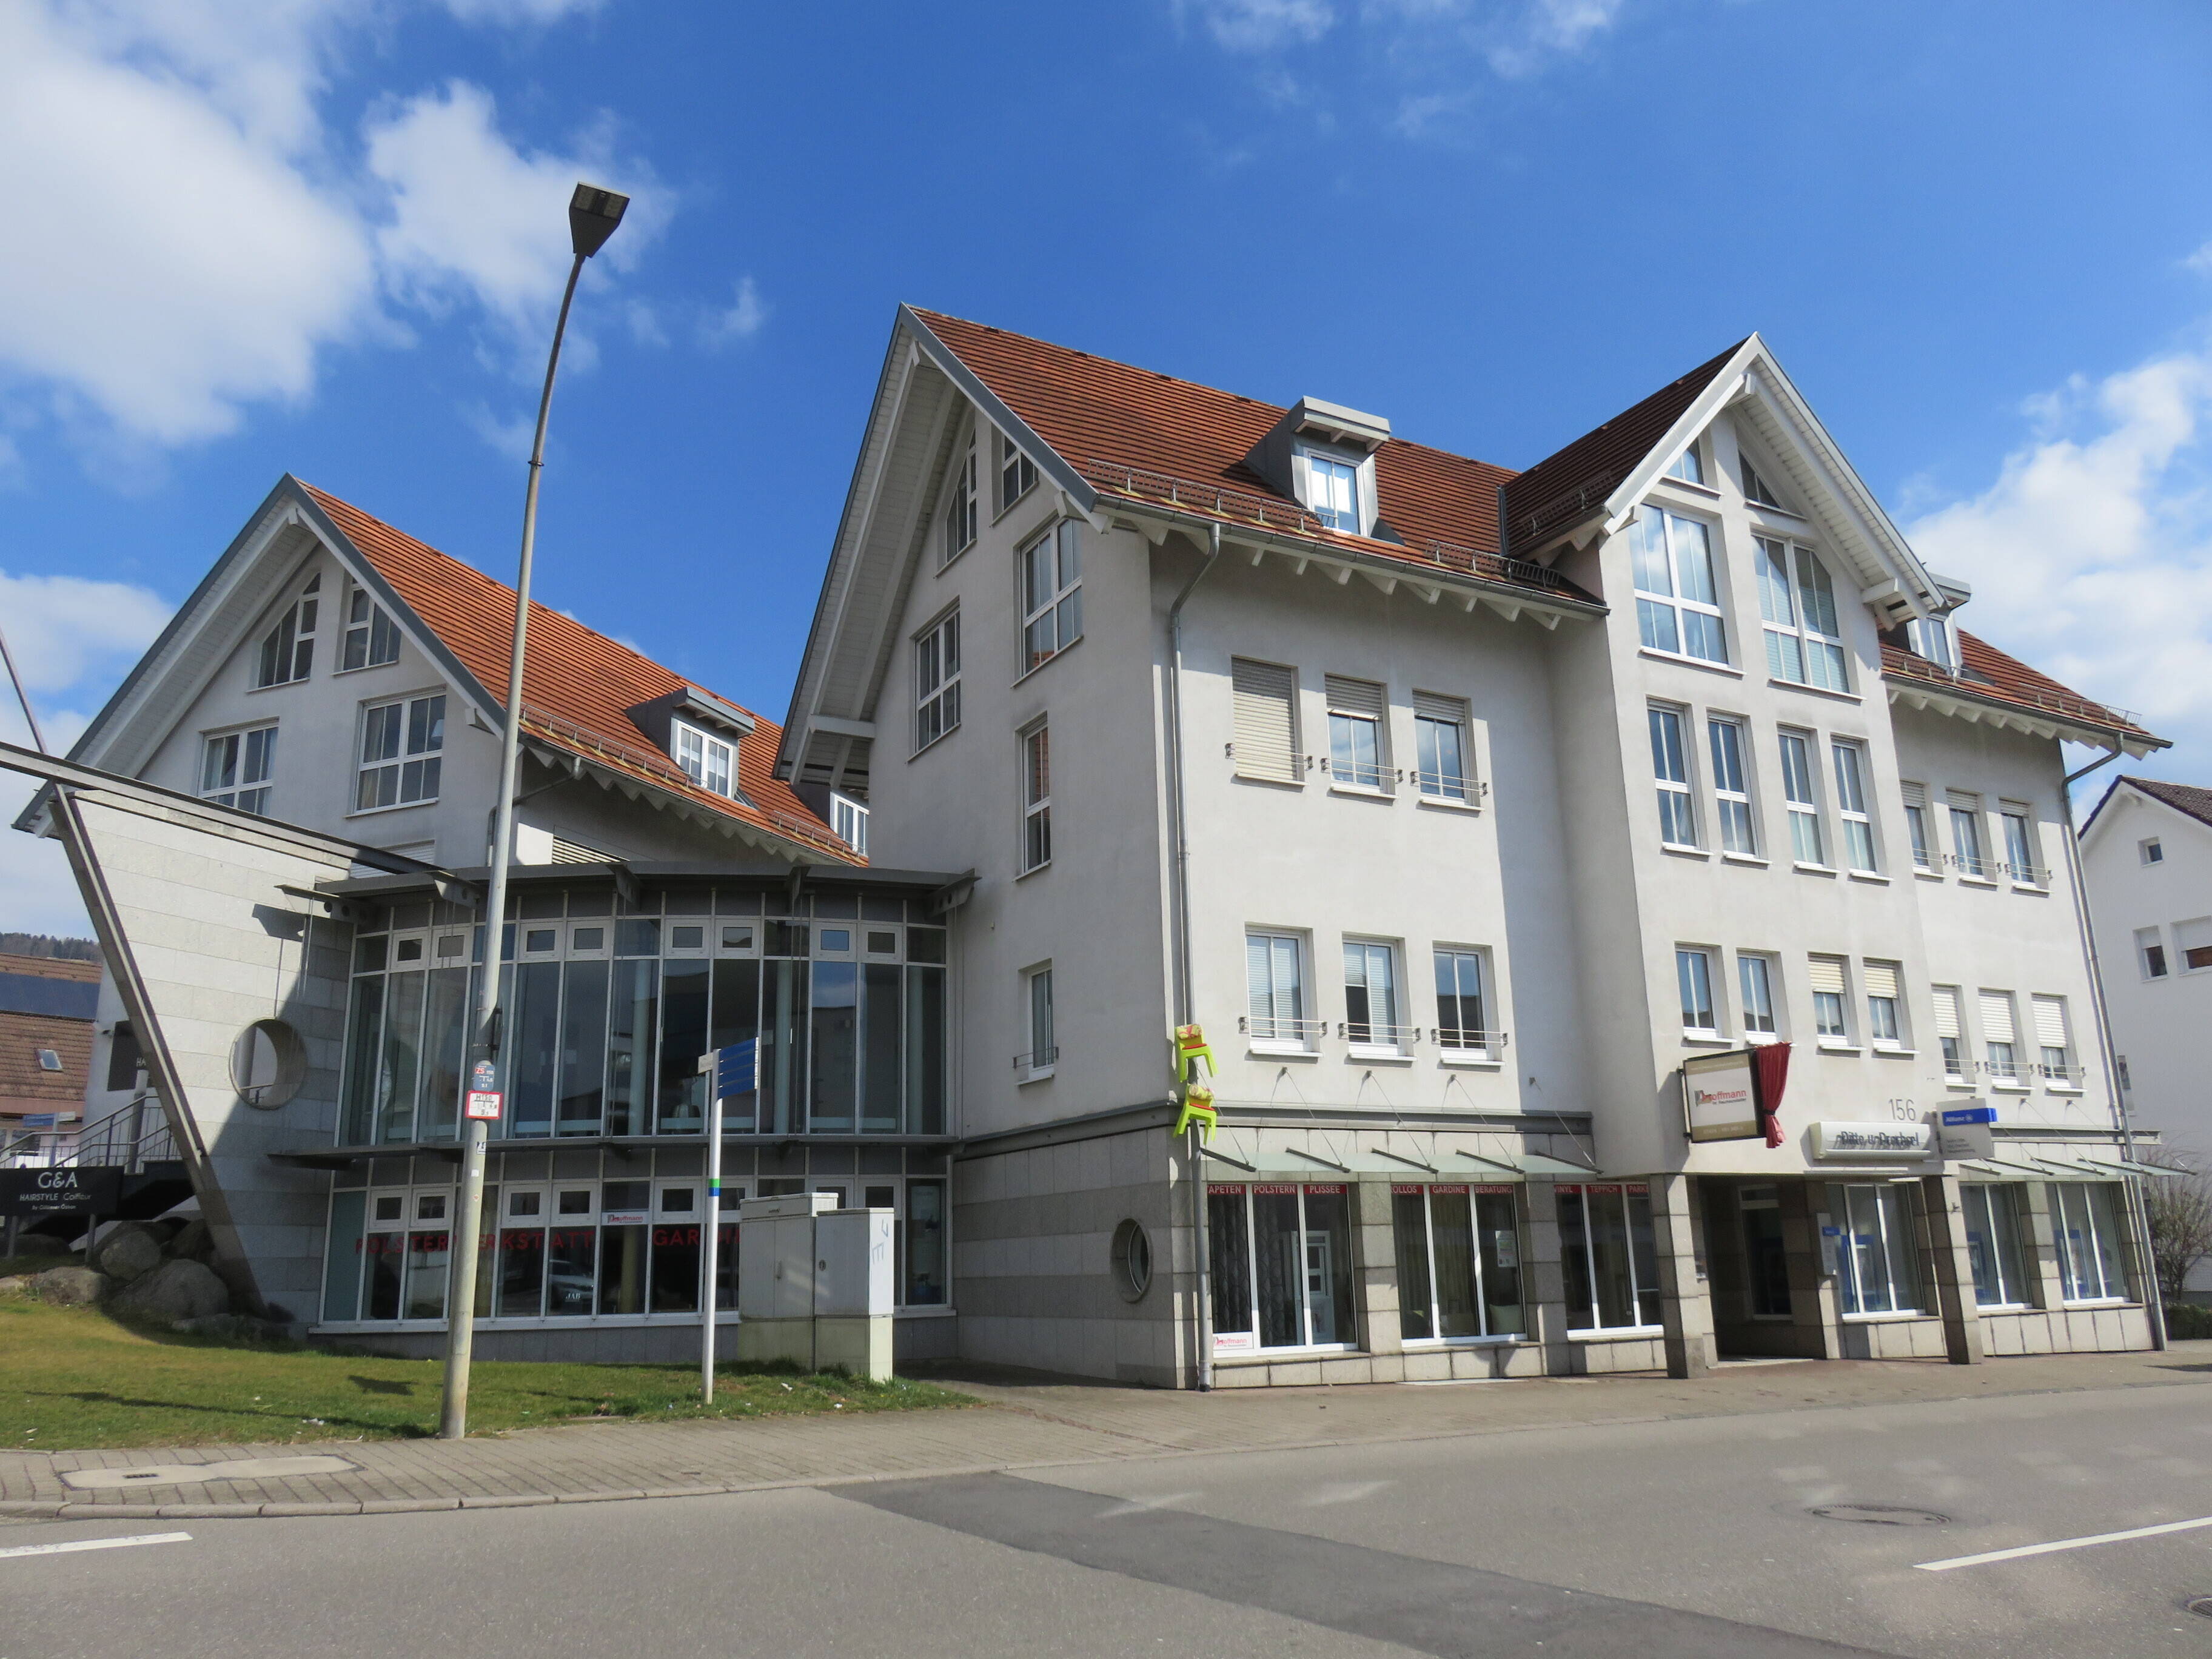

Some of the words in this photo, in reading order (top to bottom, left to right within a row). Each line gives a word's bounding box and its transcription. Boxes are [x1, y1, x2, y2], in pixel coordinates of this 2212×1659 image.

[1888, 1098, 1916, 1121] 156
[38, 1171, 78, 1188] G&A
[1205, 1185, 1241, 1194] APETEN
[1253, 1184, 1296, 1194] POLSTERN
[1309, 1185, 1341, 1194] PLISSEE
[1432, 1185, 1466, 1194] GARDINE
[1475, 1185, 1513, 1194] BERATUNG
[19, 1193, 59, 1201] HAIRSTYLE
[63, 1192, 92, 1201] Coiffeur
